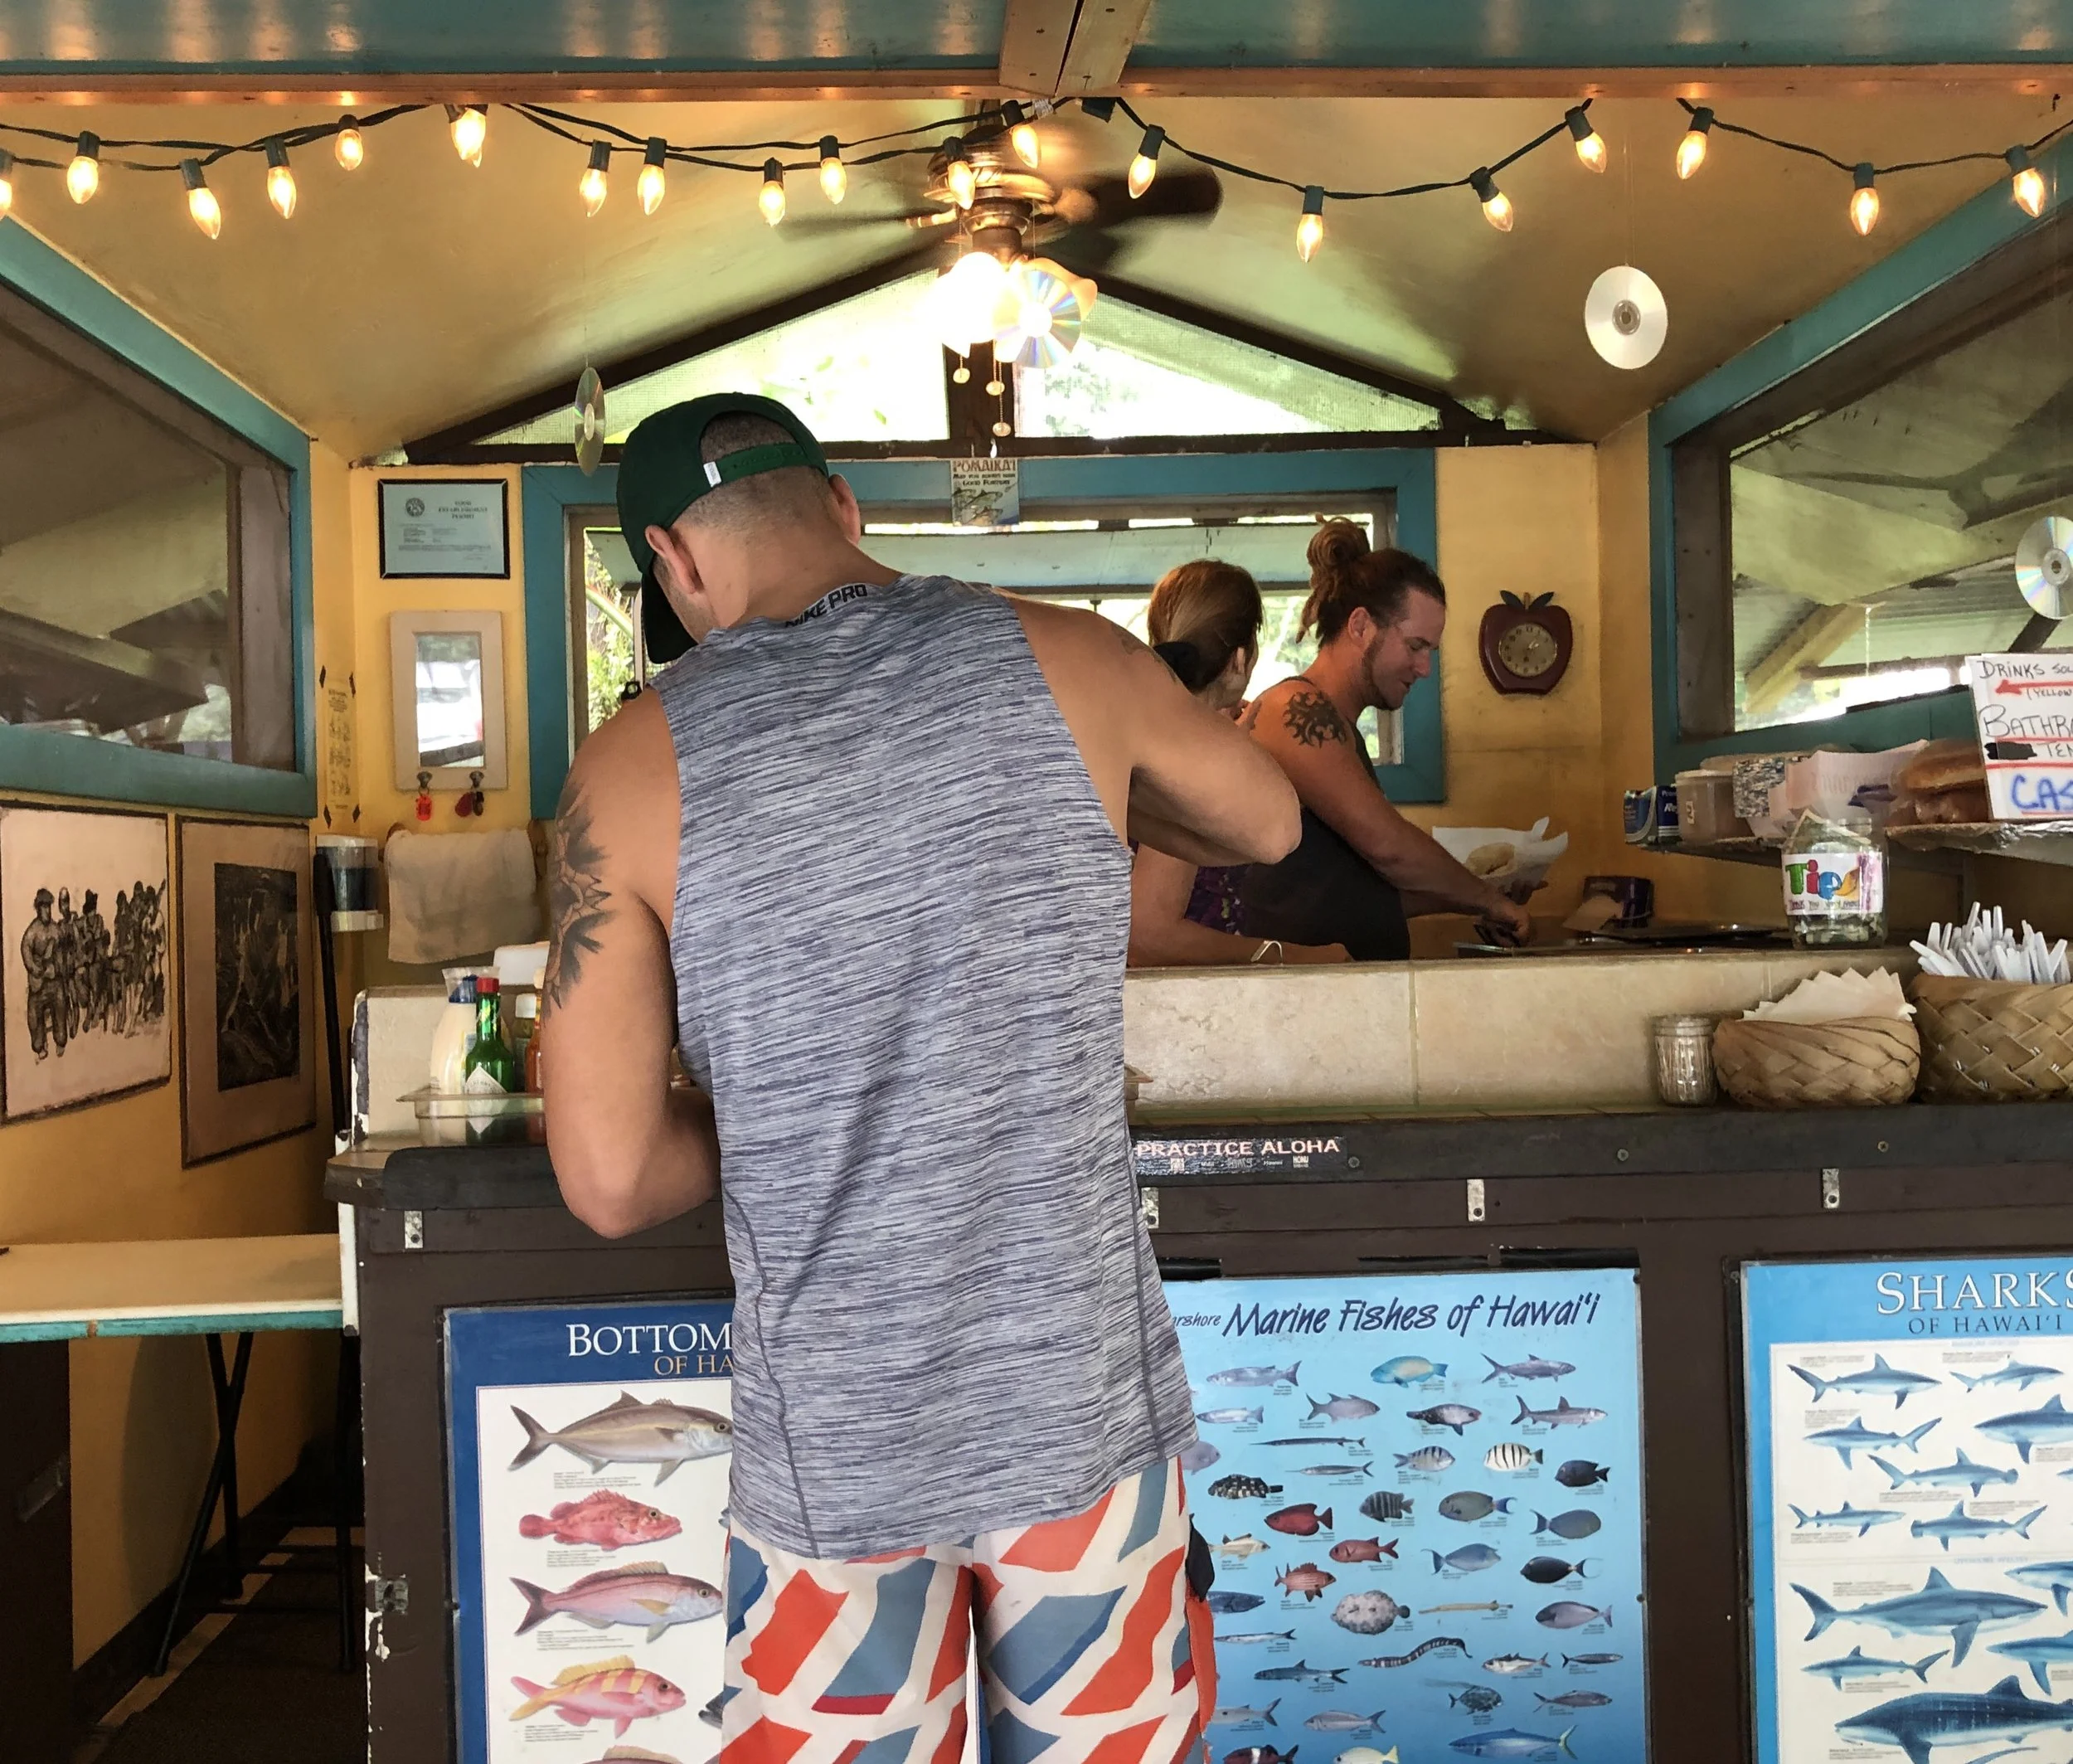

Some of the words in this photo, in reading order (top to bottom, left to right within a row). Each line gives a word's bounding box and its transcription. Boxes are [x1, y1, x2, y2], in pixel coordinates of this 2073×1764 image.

[828, 584, 868, 610] PRO
[1976, 660, 2045, 679] DRINKS
[1978, 704, 2073, 738] BATHR
[1136, 1141, 1254, 1157] PRACTICE
[1261, 1139, 1340, 1154] ALOHA
[1221, 1302, 1330, 1337] Marine
[1337, 1296, 1439, 1332] Fishes
[1446, 1294, 1484, 1338] of
[1908, 1317, 1940, 1334] OF
[566, 1322, 732, 1357] BOTTOM
[654, 1355, 688, 1376] OF
